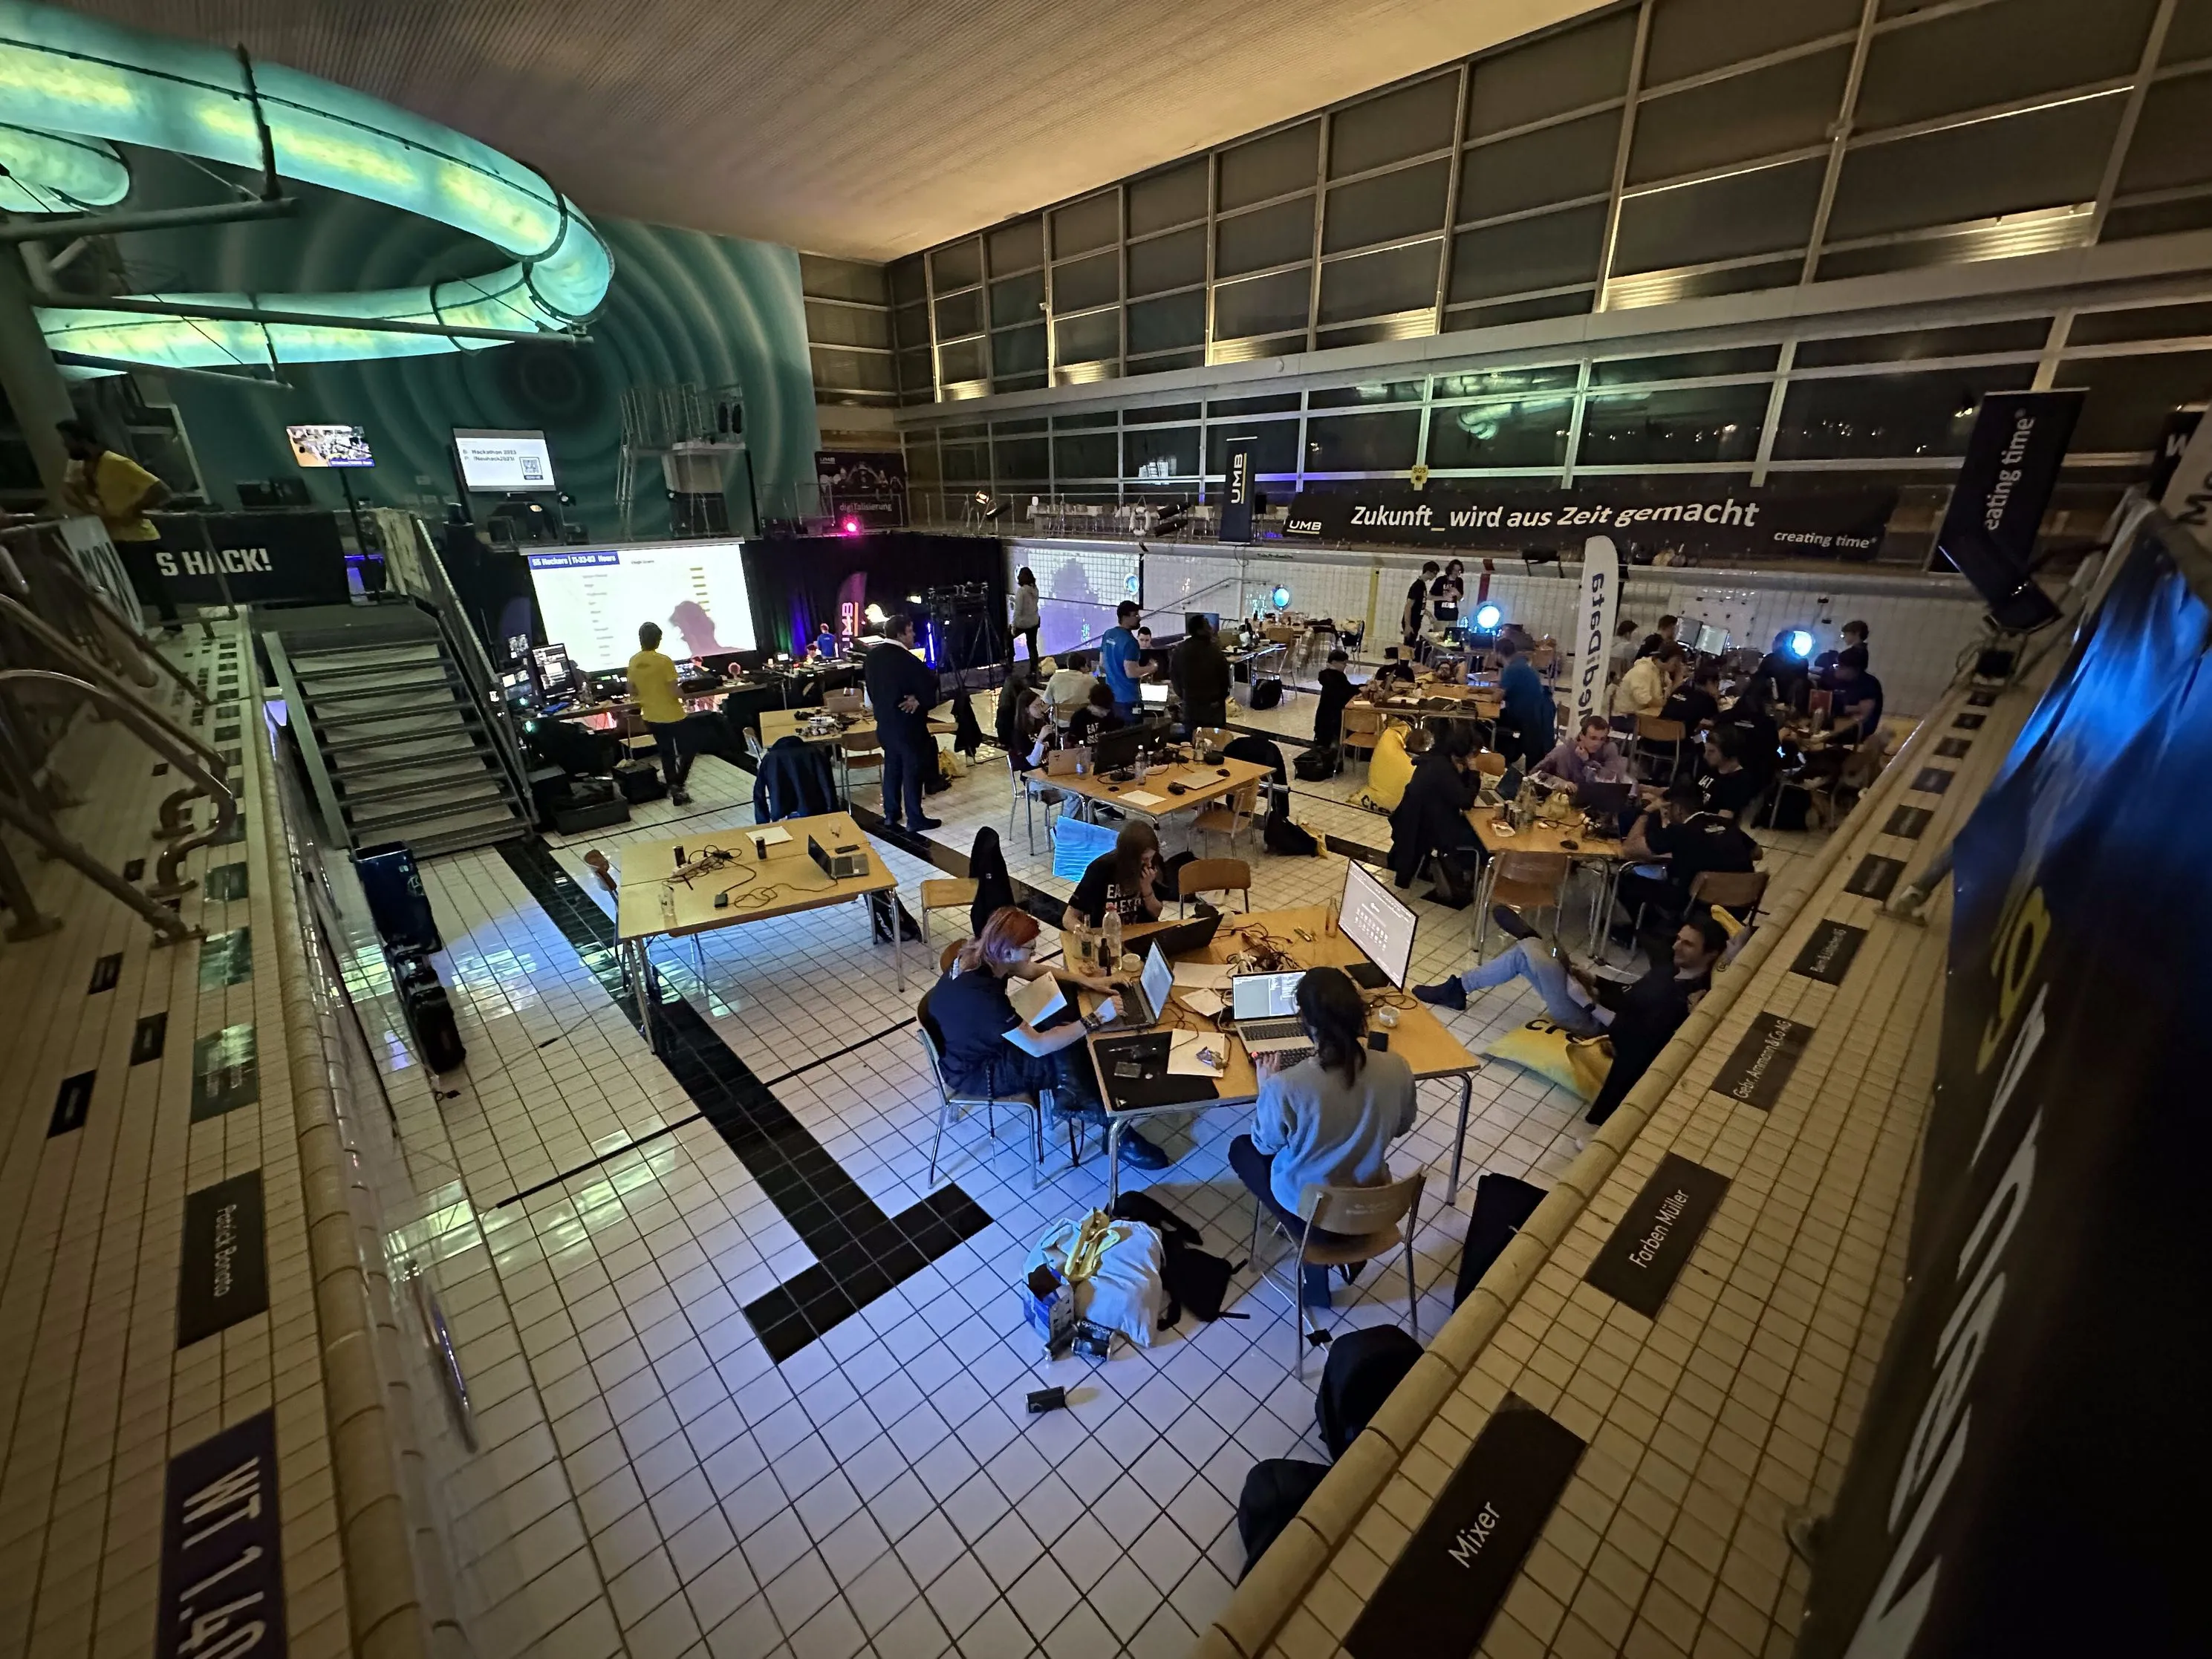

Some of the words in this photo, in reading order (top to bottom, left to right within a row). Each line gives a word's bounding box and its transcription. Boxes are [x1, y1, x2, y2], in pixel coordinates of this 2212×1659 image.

[1231, 453, 1243, 504] UMB
[1289, 520, 1322, 531] UMB
[1450, 506, 1504, 527] wird
[1506, 510, 1552, 528] aus
[1556, 504, 1613, 527] Zeit
[1613, 498, 1760, 528] gemacht
[181, 548, 273, 576] HACK!
[1774, 532, 1833, 548] creating
[1746, 1045, 1778, 1080] Ammann
[215, 1204, 238, 1250] Patrick
[1628, 1225, 1670, 1268] Farben
[1655, 1189, 1690, 1226] Müller
[182, 1456, 261, 1551] WT
[1448, 1501, 1500, 1568] Mixer
